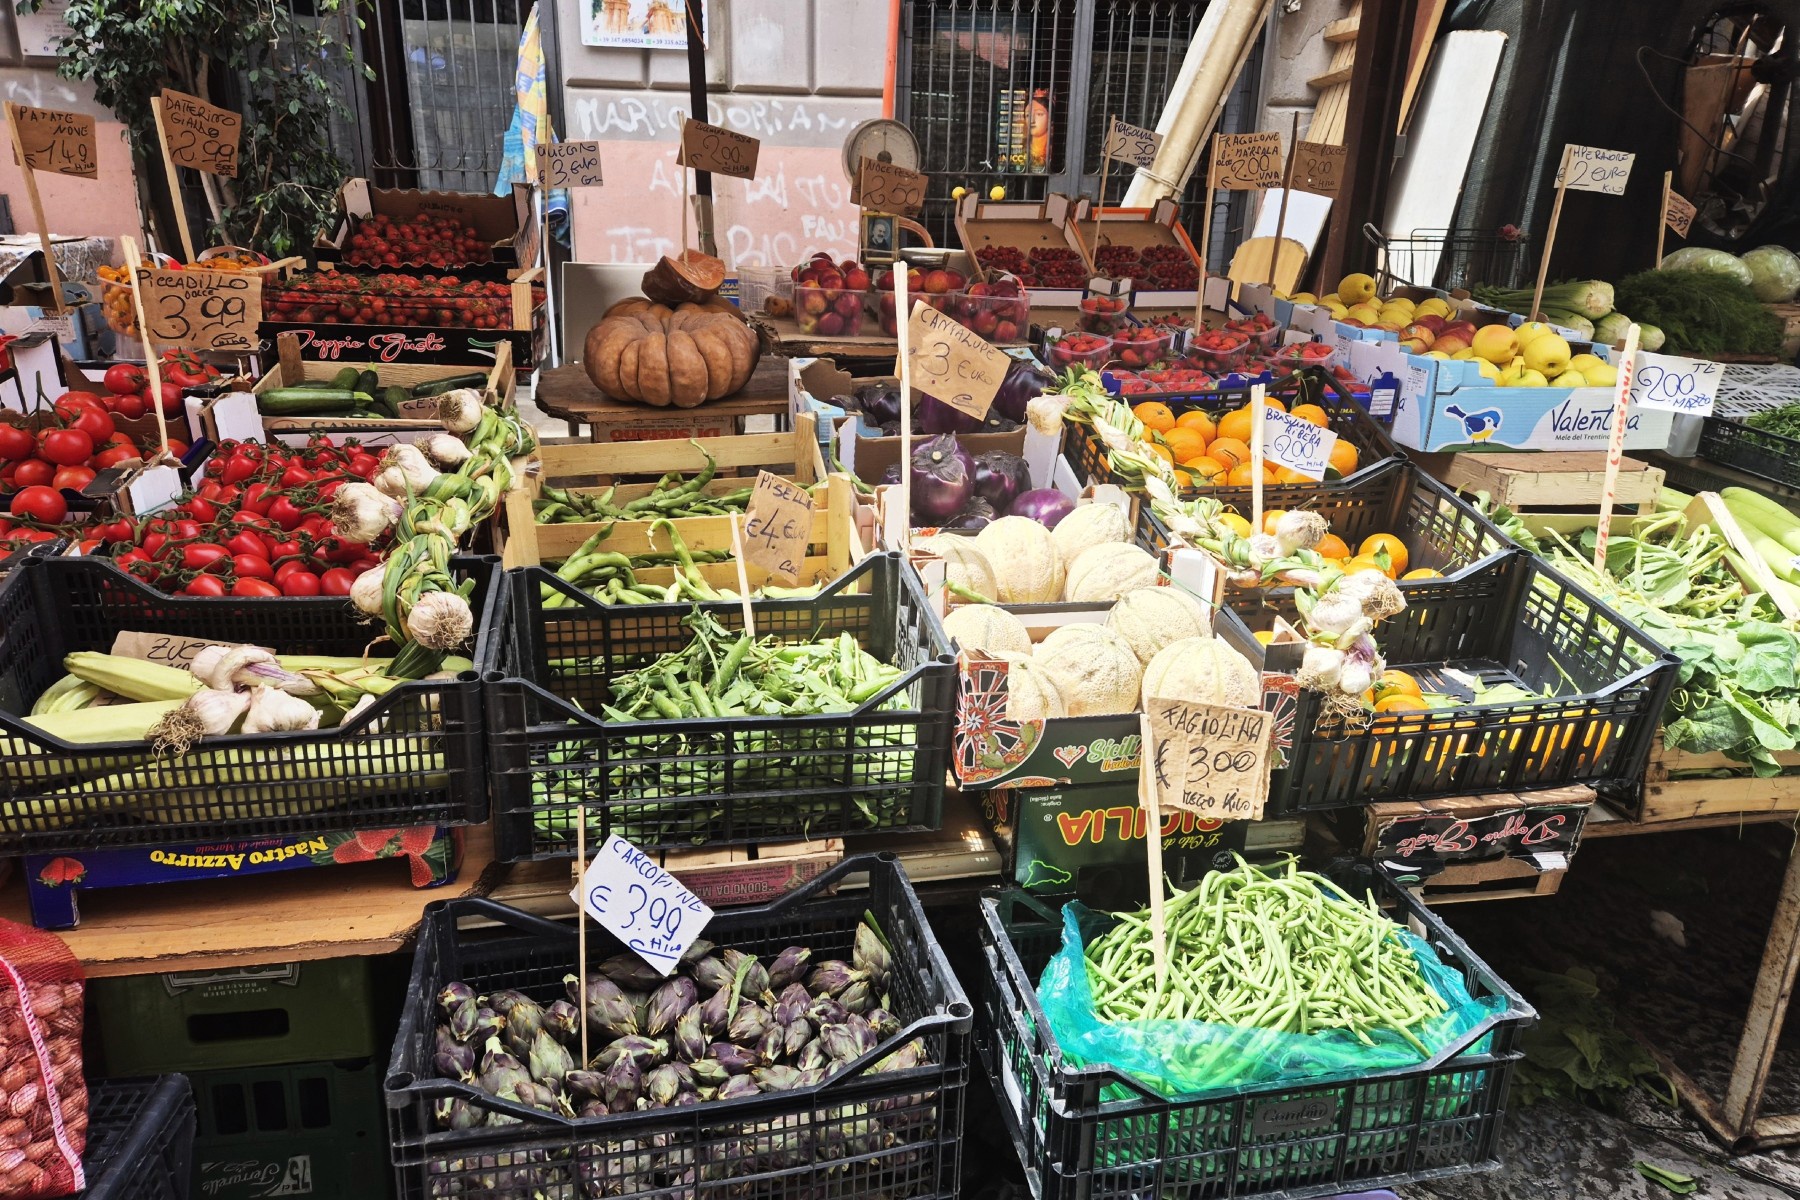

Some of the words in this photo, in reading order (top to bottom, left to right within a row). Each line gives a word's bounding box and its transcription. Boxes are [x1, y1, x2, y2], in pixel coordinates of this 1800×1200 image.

[369, 333, 447, 362] Gusto
[1551, 399, 1640, 433] Valenta
[1395, 821, 1478, 858] Gusto
[1481, 814, 1567, 846] Doppio
[150, 849, 247, 870] Azzurro
[249, 836, 329, 865] Nastro
[716, 885, 731, 896] DA
[202, 1162, 280, 1195] Ferrarelle
